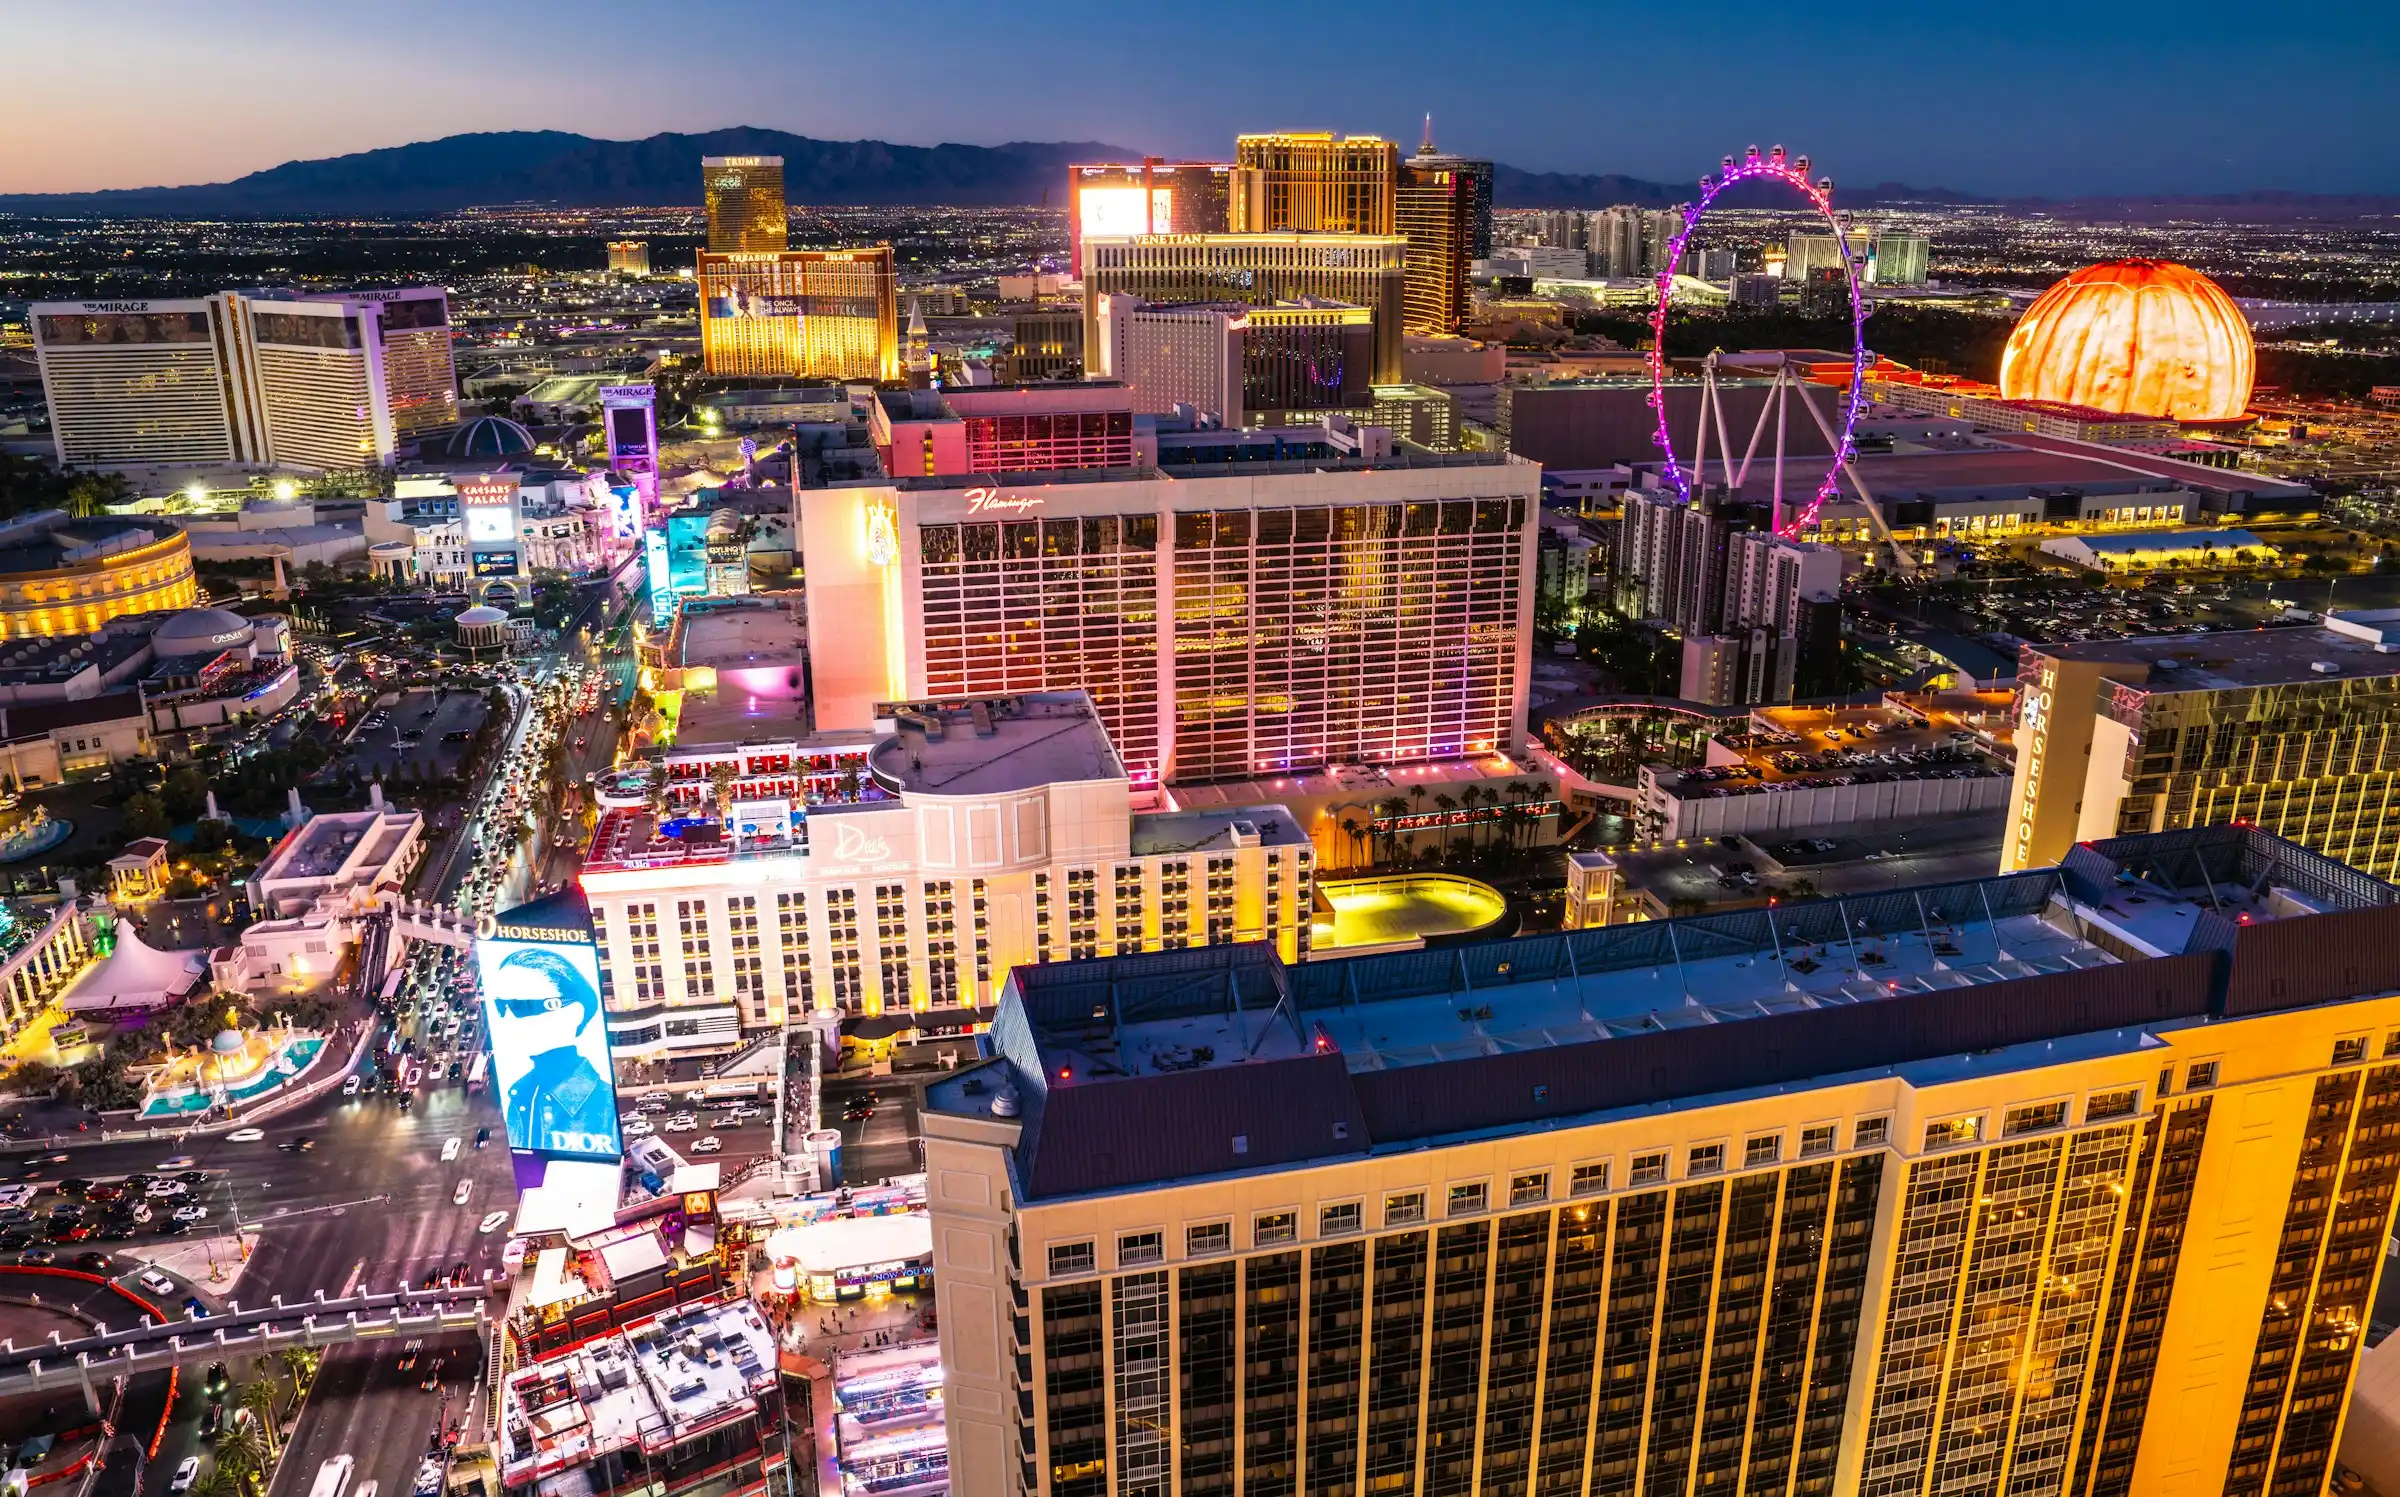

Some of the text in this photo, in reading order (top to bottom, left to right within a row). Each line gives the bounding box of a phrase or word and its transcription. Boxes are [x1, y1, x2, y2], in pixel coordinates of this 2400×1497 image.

[725, 158, 760, 166] TRUMP
[1133, 234, 1202, 244] VENETIAN
[360, 291, 401, 301] MIRAGE
[93, 302, 149, 312] MIRAGE
[611, 387, 653, 397] MIRAGE
[463, 485, 510, 494] CAESARS
[467, 495, 509, 504] PALACE
[964, 488, 1044, 514] Flamingo
[212, 631, 243, 643] OMNIA
[2017, 669, 2056, 862] HORSESHOE
[496, 925, 592, 943] HORSESHOE
[551, 1131, 615, 1153] DIOR
[848, 1275, 867, 1286] YOU
[870, 1271, 898, 1282] KNOW
[901, 1268, 920, 1277] YOU
